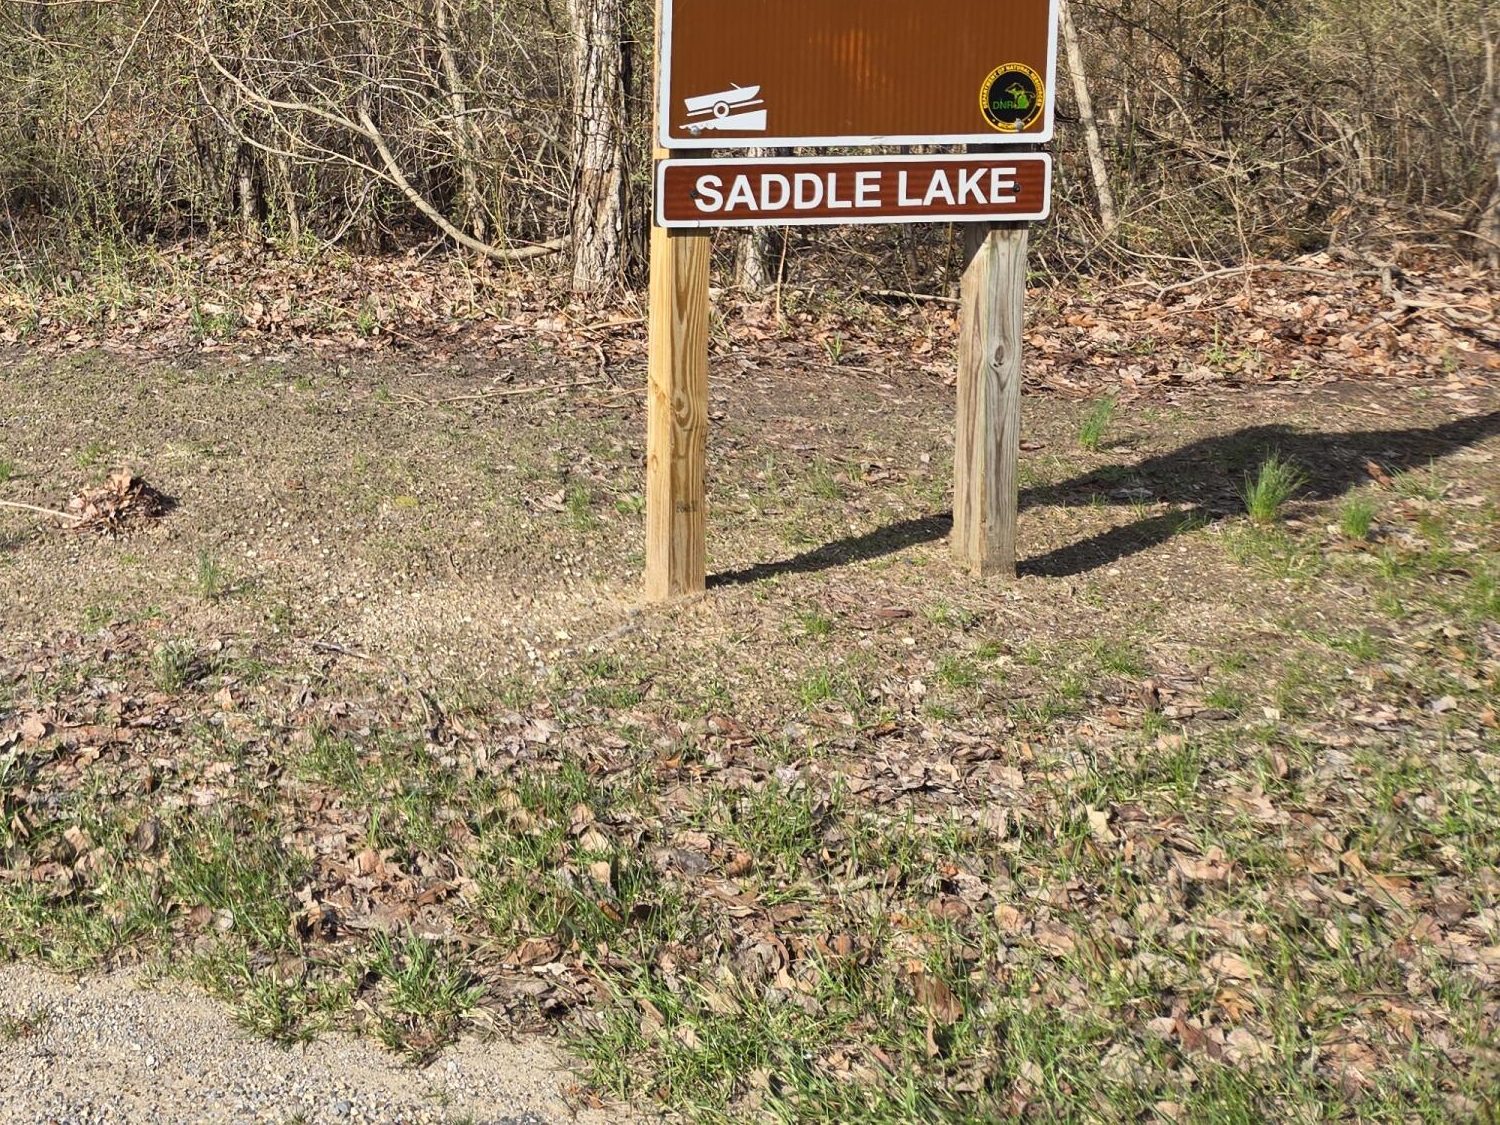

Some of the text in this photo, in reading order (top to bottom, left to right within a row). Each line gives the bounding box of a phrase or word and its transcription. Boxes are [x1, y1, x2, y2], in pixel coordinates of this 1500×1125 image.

[992, 100, 1014, 110] DNR
[694, 167, 1017, 213] SADDLE LAKE
